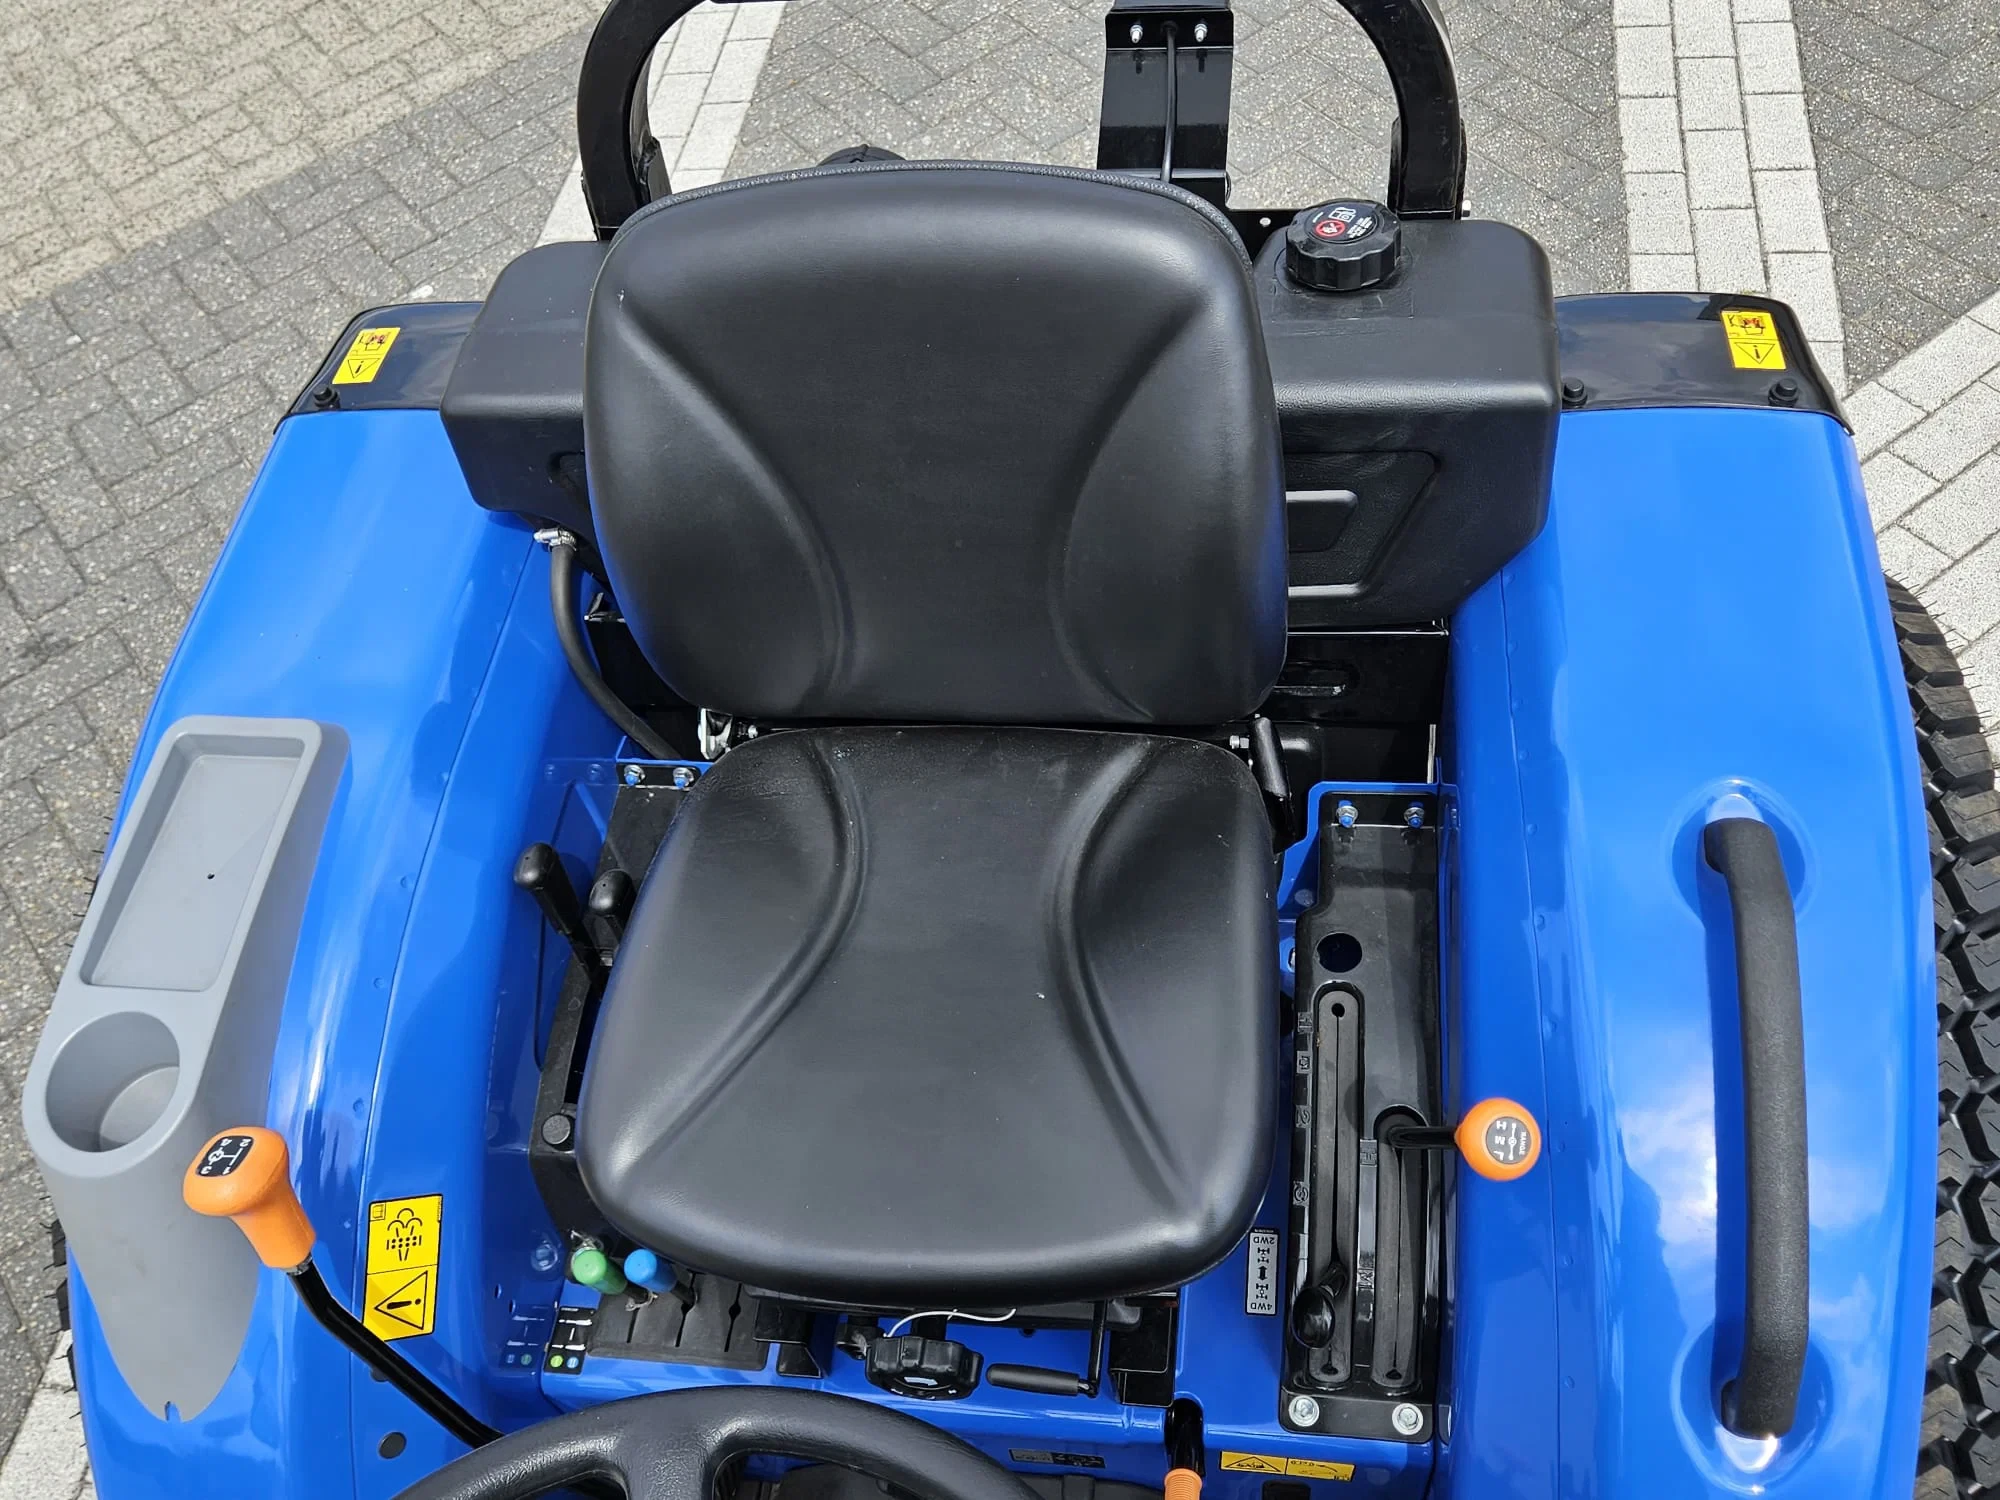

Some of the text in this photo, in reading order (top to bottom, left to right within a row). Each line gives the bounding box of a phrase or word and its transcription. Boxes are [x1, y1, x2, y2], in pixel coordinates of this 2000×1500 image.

[1496, 1120, 1507, 1130] H
[221, 1138, 232, 1146] 4
[239, 1138, 252, 1147] 2
[1495, 1136, 1506, 1145] M
[1519, 1131, 1527, 1156] RANGE
[1493, 1150, 1504, 1161] L
[200, 1166, 212, 1174] 3
[222, 1166, 231, 1175] 1
[1253, 1236, 1275, 1245] 2WD
[1250, 1302, 1272, 1311] 4WD
